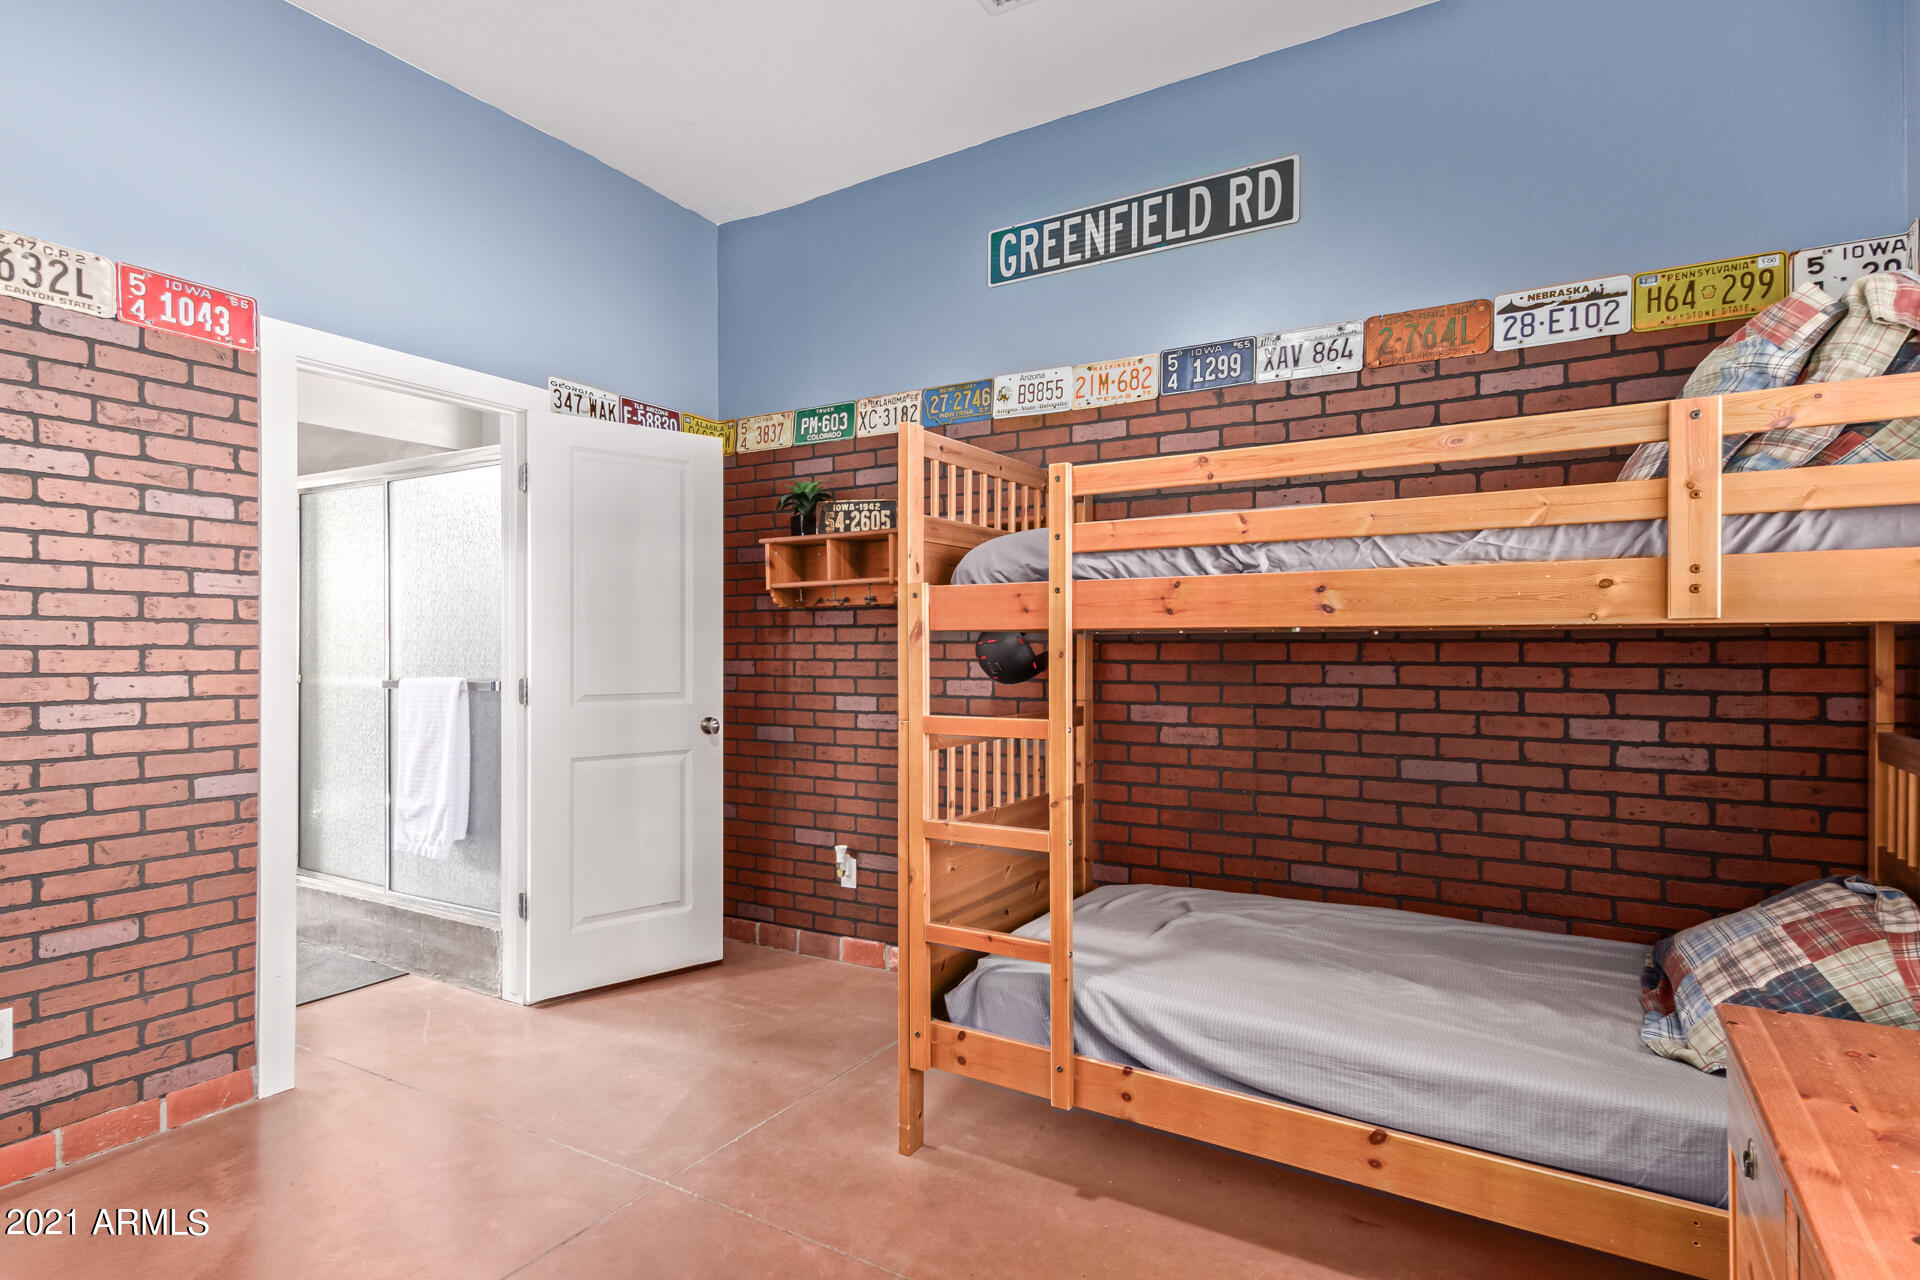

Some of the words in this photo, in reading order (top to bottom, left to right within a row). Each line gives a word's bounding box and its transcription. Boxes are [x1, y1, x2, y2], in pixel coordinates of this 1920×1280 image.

[999, 185, 1212, 278] GREENFIELD
[1229, 168, 1282, 227] RD
[14, 237, 37, 251] 47
[75, 254, 86, 265] 2
[1843, 238, 1907, 260] IOWA
[0, 248, 94, 300] 632L
[1667, 261, 1750, 283] PENNSYLVANIA
[1807, 256, 1825, 275] 5
[129, 272, 146, 296] 5
[165, 279, 212, 300] IOWA
[1527, 285, 1590, 302] NEBRASKA
[1647, 280, 1696, 314] H64
[1721, 268, 1774, 305] 299
[4, 285, 55, 302] CANYON
[59, 297, 95, 311] STATE
[130, 299, 146, 321] 4
[159, 291, 230, 337] 1043
[1721, 303, 1749, 315] STATE
[1191, 345, 1223, 358] IOWA
[1264, 343, 1303, 372] XAV
[1313, 337, 1353, 364] 864
[1167, 354, 1179, 371] 5
[1192, 353, 1242, 383] 1299
[1020, 373, 1046, 382] Arizona
[1167, 372, 1179, 390] 4
[550, 380, 595, 397] GEORGIA
[1018, 379, 1064, 405] B9855
[553, 388, 583, 414] 347
[589, 397, 617, 423] WAK
[646, 406, 669, 417] ARIZONA
[871, 396, 907, 409] OKLAHOMA
[754, 416, 774, 424] IOWA
[939, 408, 974, 419] MONTANA
[694, 421, 725, 432] ALASKA
[740, 422, 748, 436] 5
[756, 422, 785, 445] 3837
[806, 430, 842, 442] COLORADO
[740, 438, 748, 449] 4
